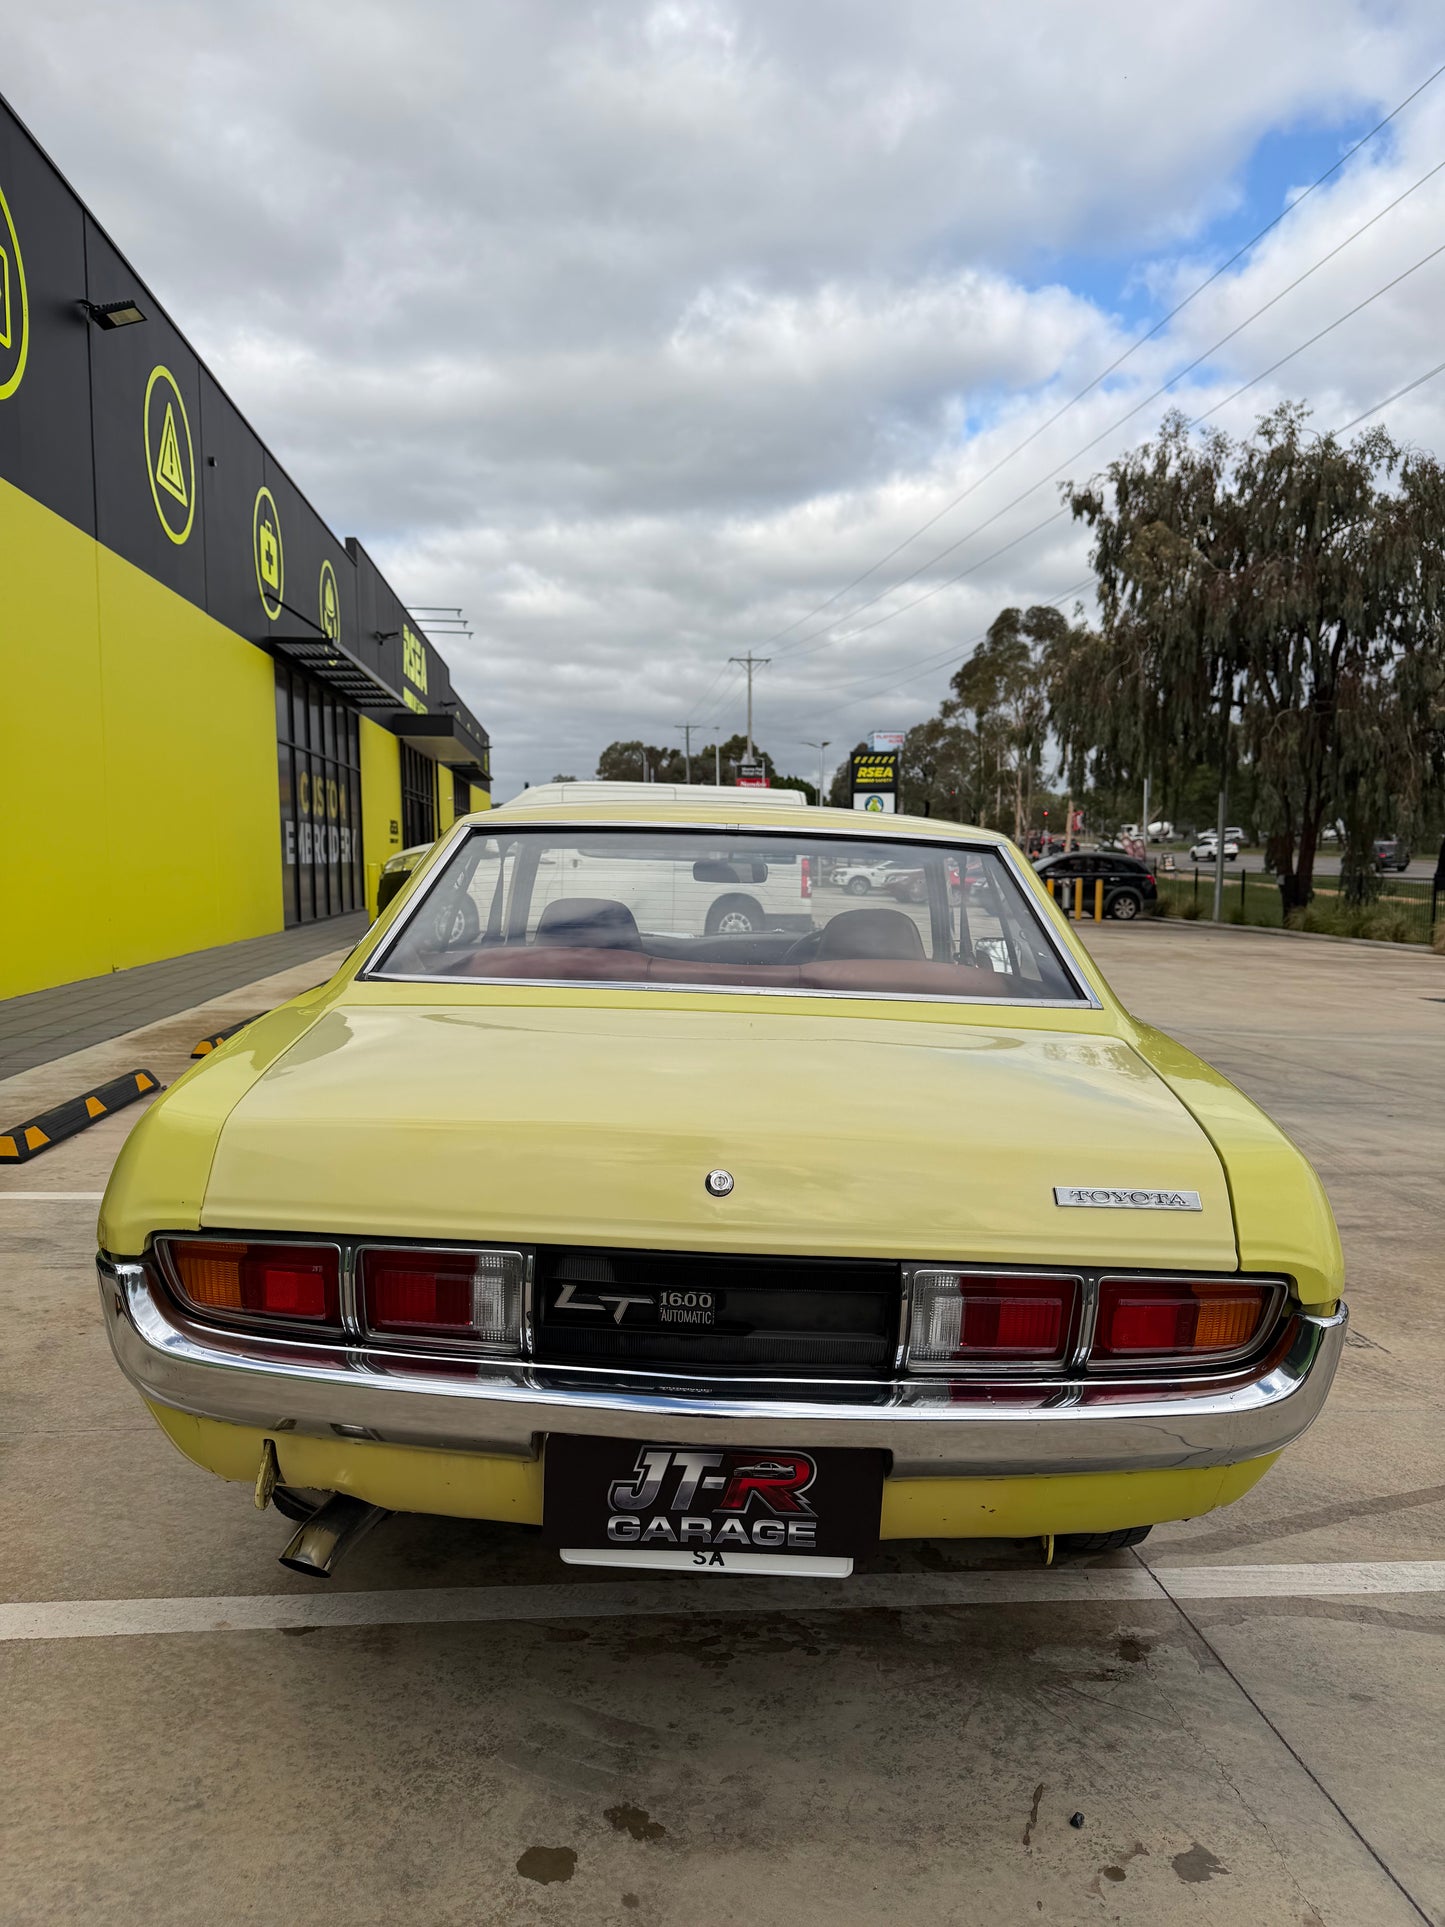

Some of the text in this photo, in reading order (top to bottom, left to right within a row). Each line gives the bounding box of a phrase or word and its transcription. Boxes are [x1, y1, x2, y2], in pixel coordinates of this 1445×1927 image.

[403, 624, 428, 695] RSEA
[857, 766, 893, 777] RSEA
[1070, 1190, 1189, 1207] TOYOTA
[554, 1284, 654, 1325] LT
[660, 1291, 712, 1308] 1600
[660, 1308, 712, 1325] AUTOMATIC
[607, 1515, 817, 1547] GARAGE
[692, 1551, 726, 1566] SA
